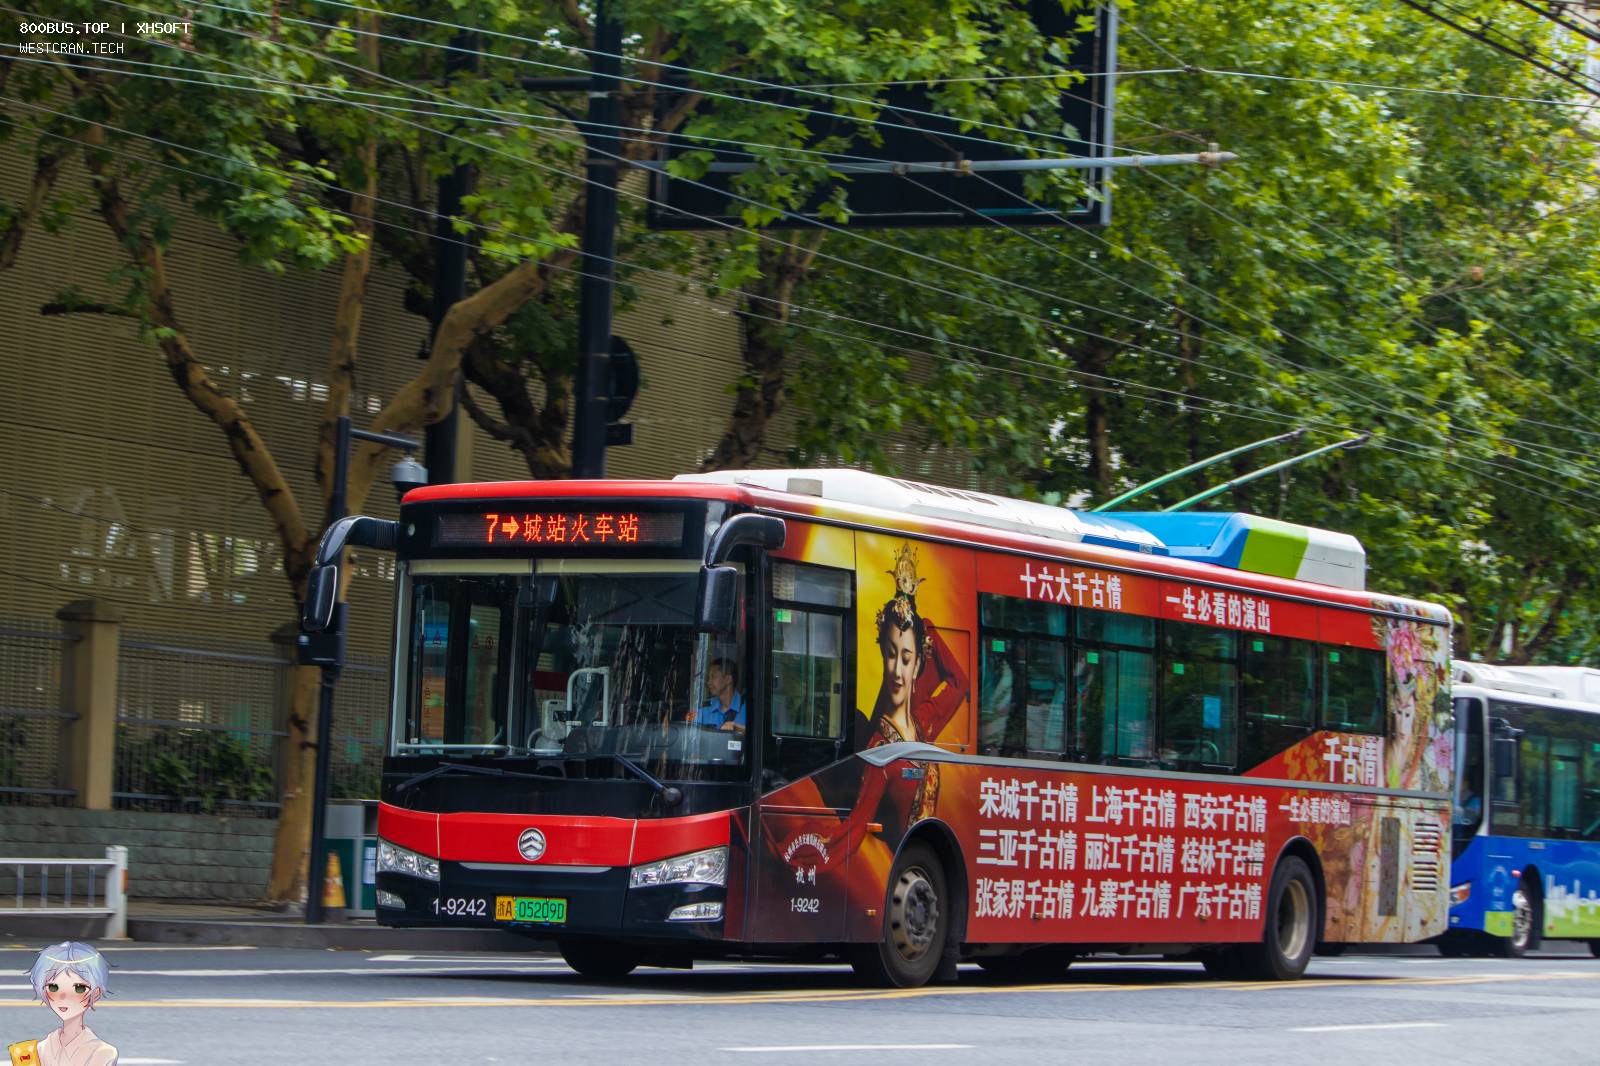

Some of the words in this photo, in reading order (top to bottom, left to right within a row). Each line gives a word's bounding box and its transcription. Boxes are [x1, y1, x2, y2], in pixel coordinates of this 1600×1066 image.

[485, 514, 498, 543] 7
[523, 513, 640, 543] 城站火车站
[1019, 562, 1123, 610] 十六大千古情
[1165, 586, 1271, 633] 一生必看的演出
[1322, 736, 1378, 785] 千古情
[978, 777, 1079, 823] 宋城千古情
[1085, 785, 1177, 829] 上海千古情
[1182, 792, 1268, 833] 西安千古情
[1278, 796, 1351, 825] 一生必看的演出
[976, 828, 1078, 871] 三亚千古情
[1083, 833, 1175, 875] 丽江千古情
[1181, 836, 1265, 877] 桂林千古情
[432, 898, 487, 916] 1-9242
[790, 898, 820, 913] 1-9242
[975, 878, 1075, 919] 张家界千古情
[1079, 878, 1172, 919] 九寨千古情
[1176, 881, 1262, 920] 广东千古情
